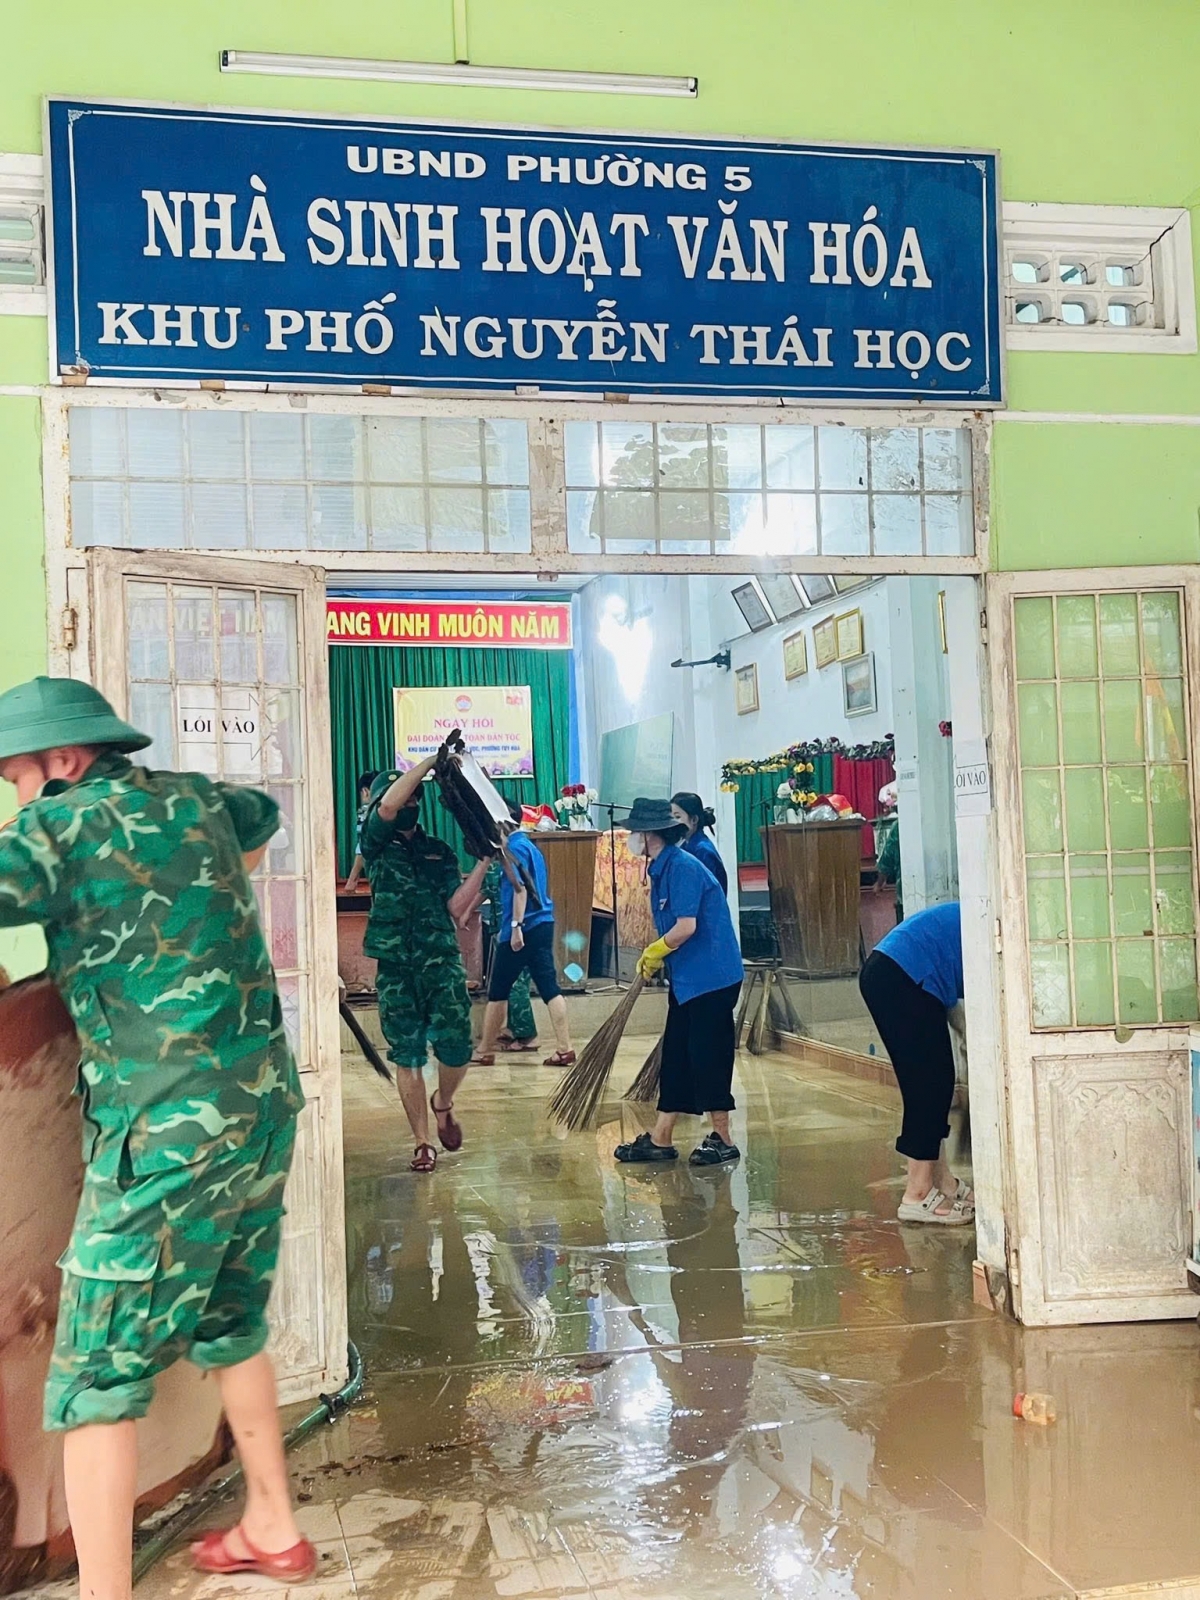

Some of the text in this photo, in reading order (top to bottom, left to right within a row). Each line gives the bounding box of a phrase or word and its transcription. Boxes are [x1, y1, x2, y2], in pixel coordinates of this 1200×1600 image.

[346, 145, 753, 192] UBND PHƯỜNG 5
[141, 174, 932, 293] NHÀ SINH HOẠT VĂN HÓA
[97, 292, 972, 380] KHU PHỐ NGUYỄN THÁI HỌC
[377, 612, 430, 637] VINH
[438, 607, 503, 638] MUÔN
[511, 610, 559, 639] NĂM
[221, 716, 255, 734] VÀO
